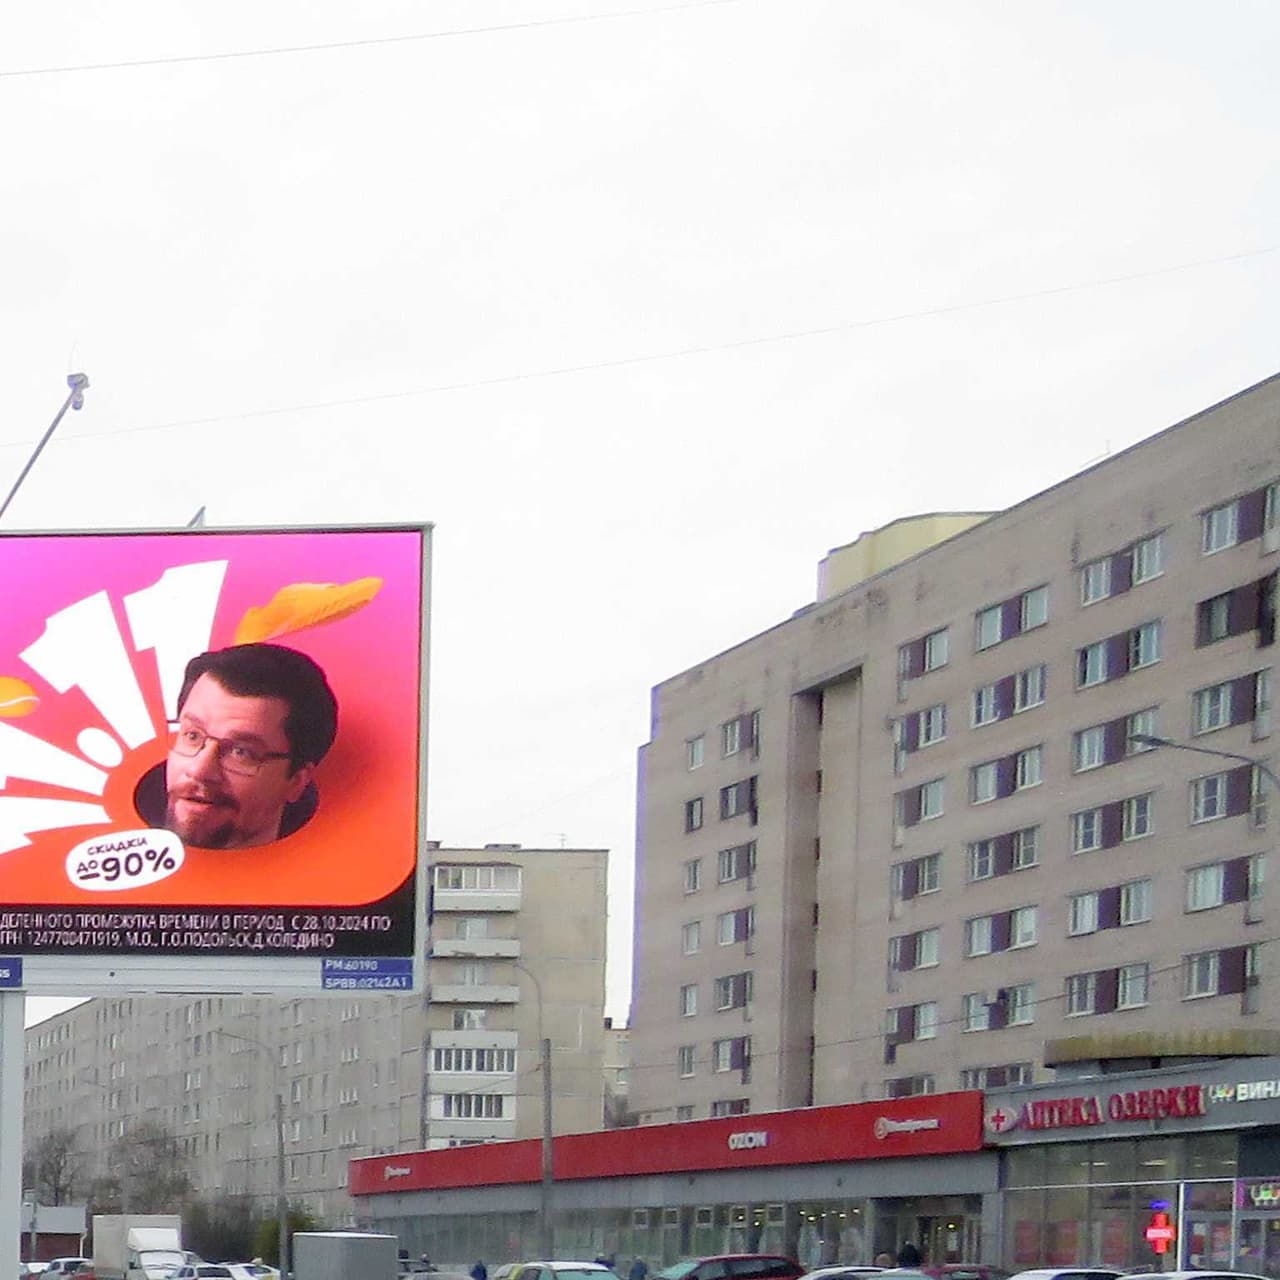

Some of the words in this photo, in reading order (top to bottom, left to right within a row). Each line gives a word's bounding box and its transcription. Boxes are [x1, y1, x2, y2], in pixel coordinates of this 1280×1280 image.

[102, 847, 175, 881] 90%
[75, 914, 157, 929] ПРОМЕЖУТКА
[159, 914, 220, 929] ВРЕМЕНИ
[222, 915, 231, 930] В
[233, 915, 284, 931] ПЕРИОД
[291, 915, 301, 930] С
[302, 915, 368, 931] 28.10.2024
[370, 916, 392, 931] ПО
[1018, 1097, 1104, 1130] АПТЕКА
[1109, 1085, 1206, 1120] ОЗЕРКИ
[728, 1131, 768, 1150] OZON
